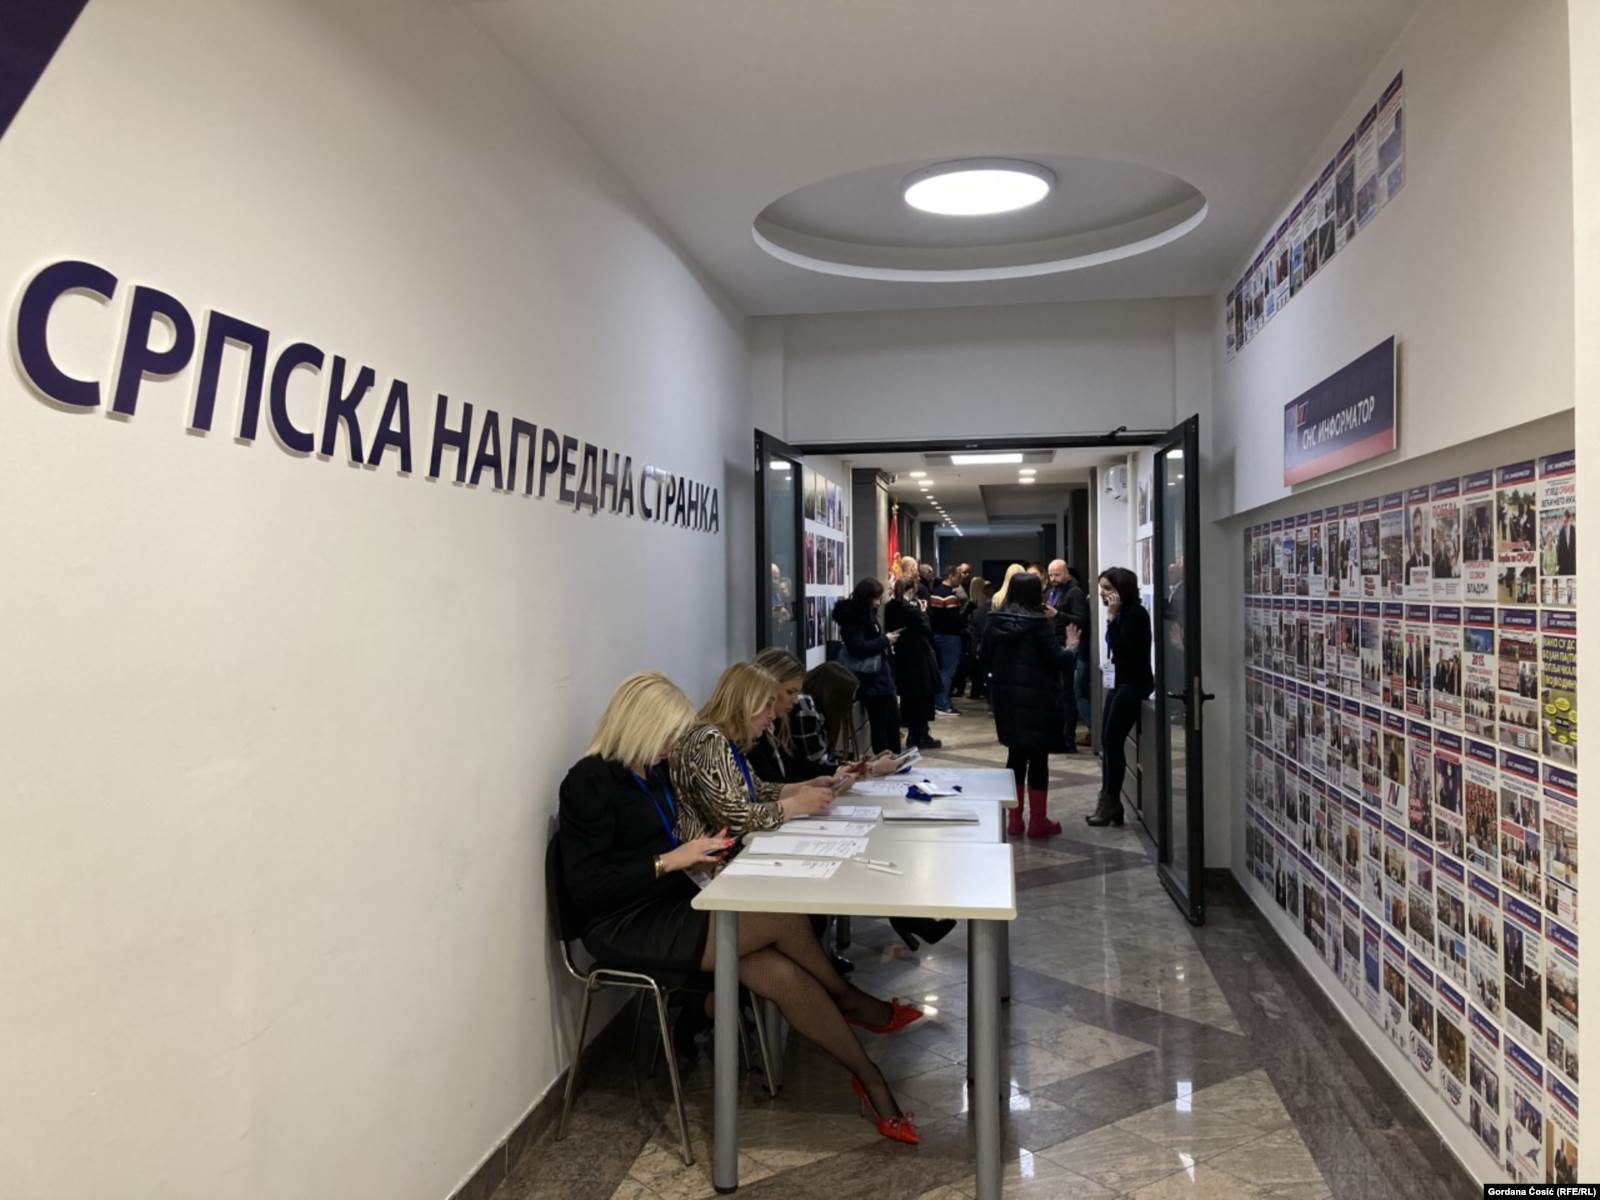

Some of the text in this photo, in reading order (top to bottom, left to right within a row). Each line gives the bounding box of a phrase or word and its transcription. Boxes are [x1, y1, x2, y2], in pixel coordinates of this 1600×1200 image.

[15, 259, 720, 532] СРПСКА НАПРЕДНА СТРАНКА
[1302, 395, 1375, 450] СНС ИНФОРМАТОР
